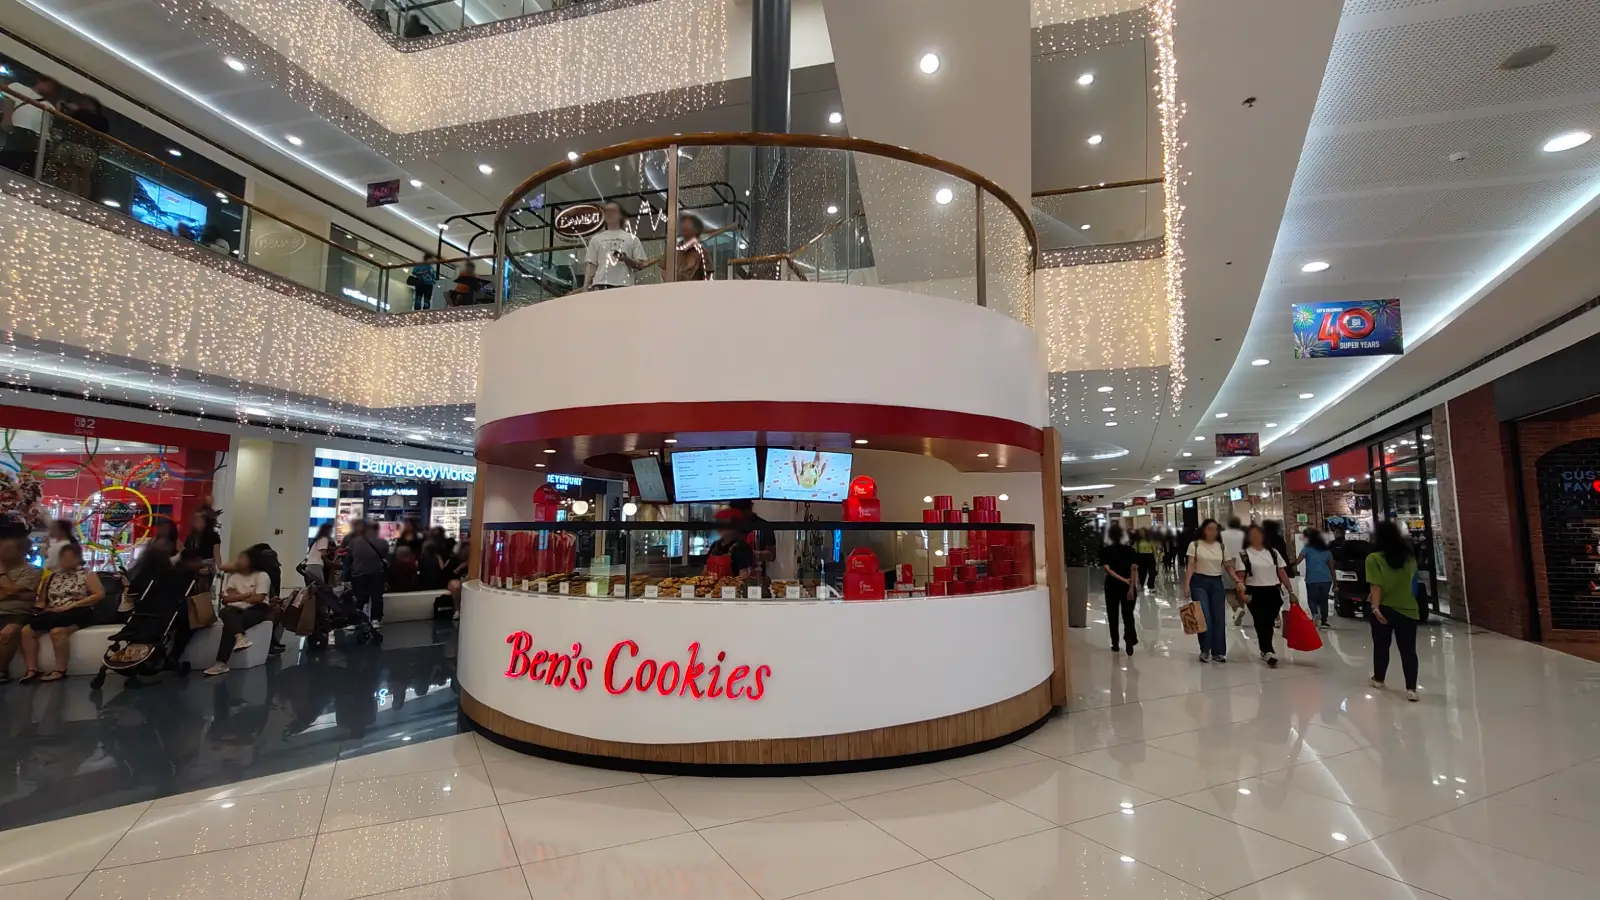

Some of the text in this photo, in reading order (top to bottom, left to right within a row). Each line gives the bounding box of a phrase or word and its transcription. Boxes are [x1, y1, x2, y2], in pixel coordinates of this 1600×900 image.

[1318, 308, 1376, 350] 40
[1340, 341, 1359, 349] SUPER
[359, 456, 475, 482] Bath & Body Works
[504, 630, 771, 700] Ben's Cookies
